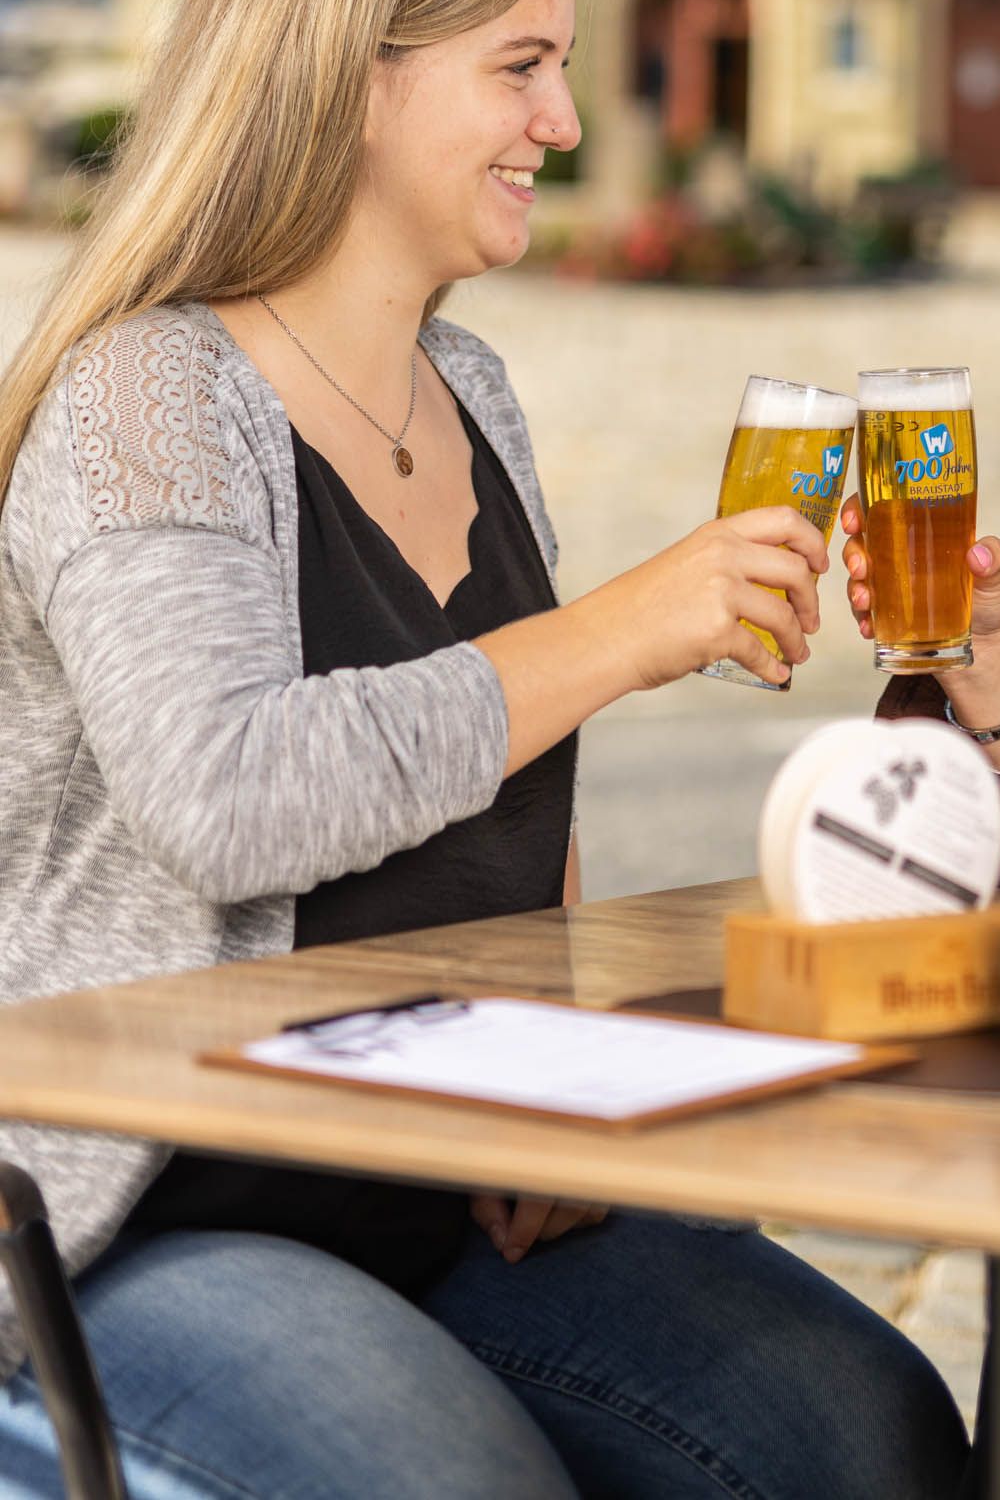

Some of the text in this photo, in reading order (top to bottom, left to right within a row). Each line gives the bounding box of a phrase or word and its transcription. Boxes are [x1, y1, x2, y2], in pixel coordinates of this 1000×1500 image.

[895, 455, 942, 484] 700
[792, 470, 833, 499] 700
[909, 482, 964, 495] BRAUSTADT
[910, 492, 964, 509] WEITRA
